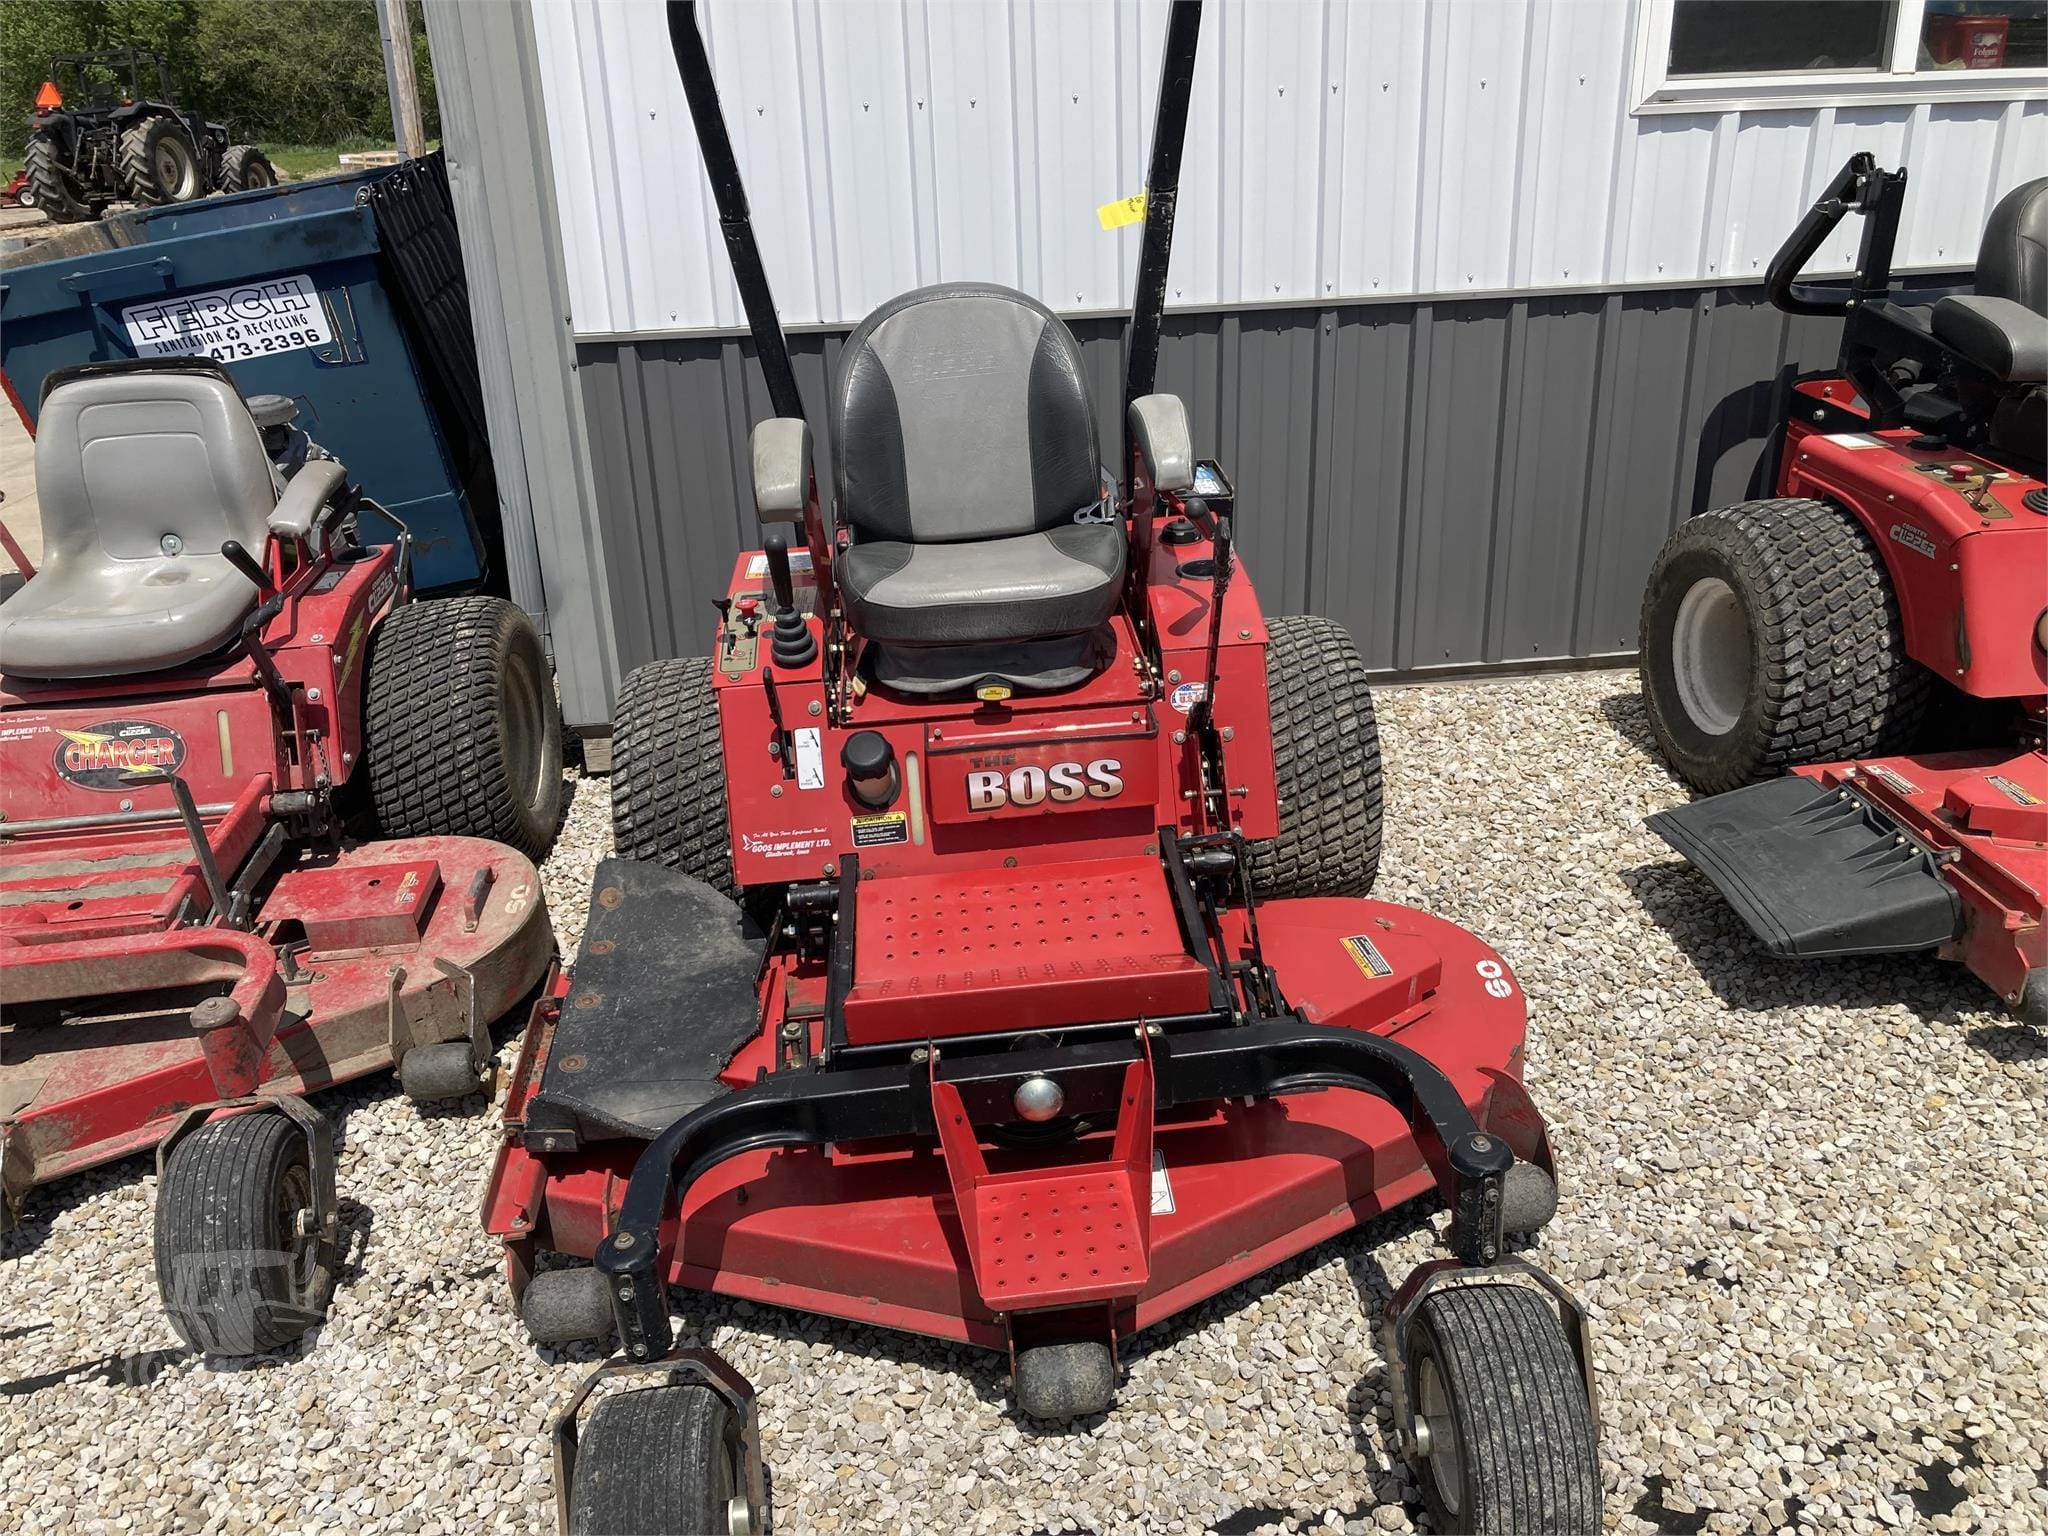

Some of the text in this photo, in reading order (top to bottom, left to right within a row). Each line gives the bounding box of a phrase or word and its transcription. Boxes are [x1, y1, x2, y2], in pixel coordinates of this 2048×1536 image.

[129, 280, 311, 340] FERCH
[155, 313, 309, 354] SANITATION RECYCLING
[210, 328, 320, 362] 473-2396
[1889, 524, 1936, 560] CLIPPER
[64, 737, 176, 772] CHARGER
[970, 753, 1016, 769] THE
[967, 759, 1124, 812] BOSS
[751, 838, 832, 853] GOOS IMPLEMENT LTD.
[1475, 959, 1513, 998] 60
